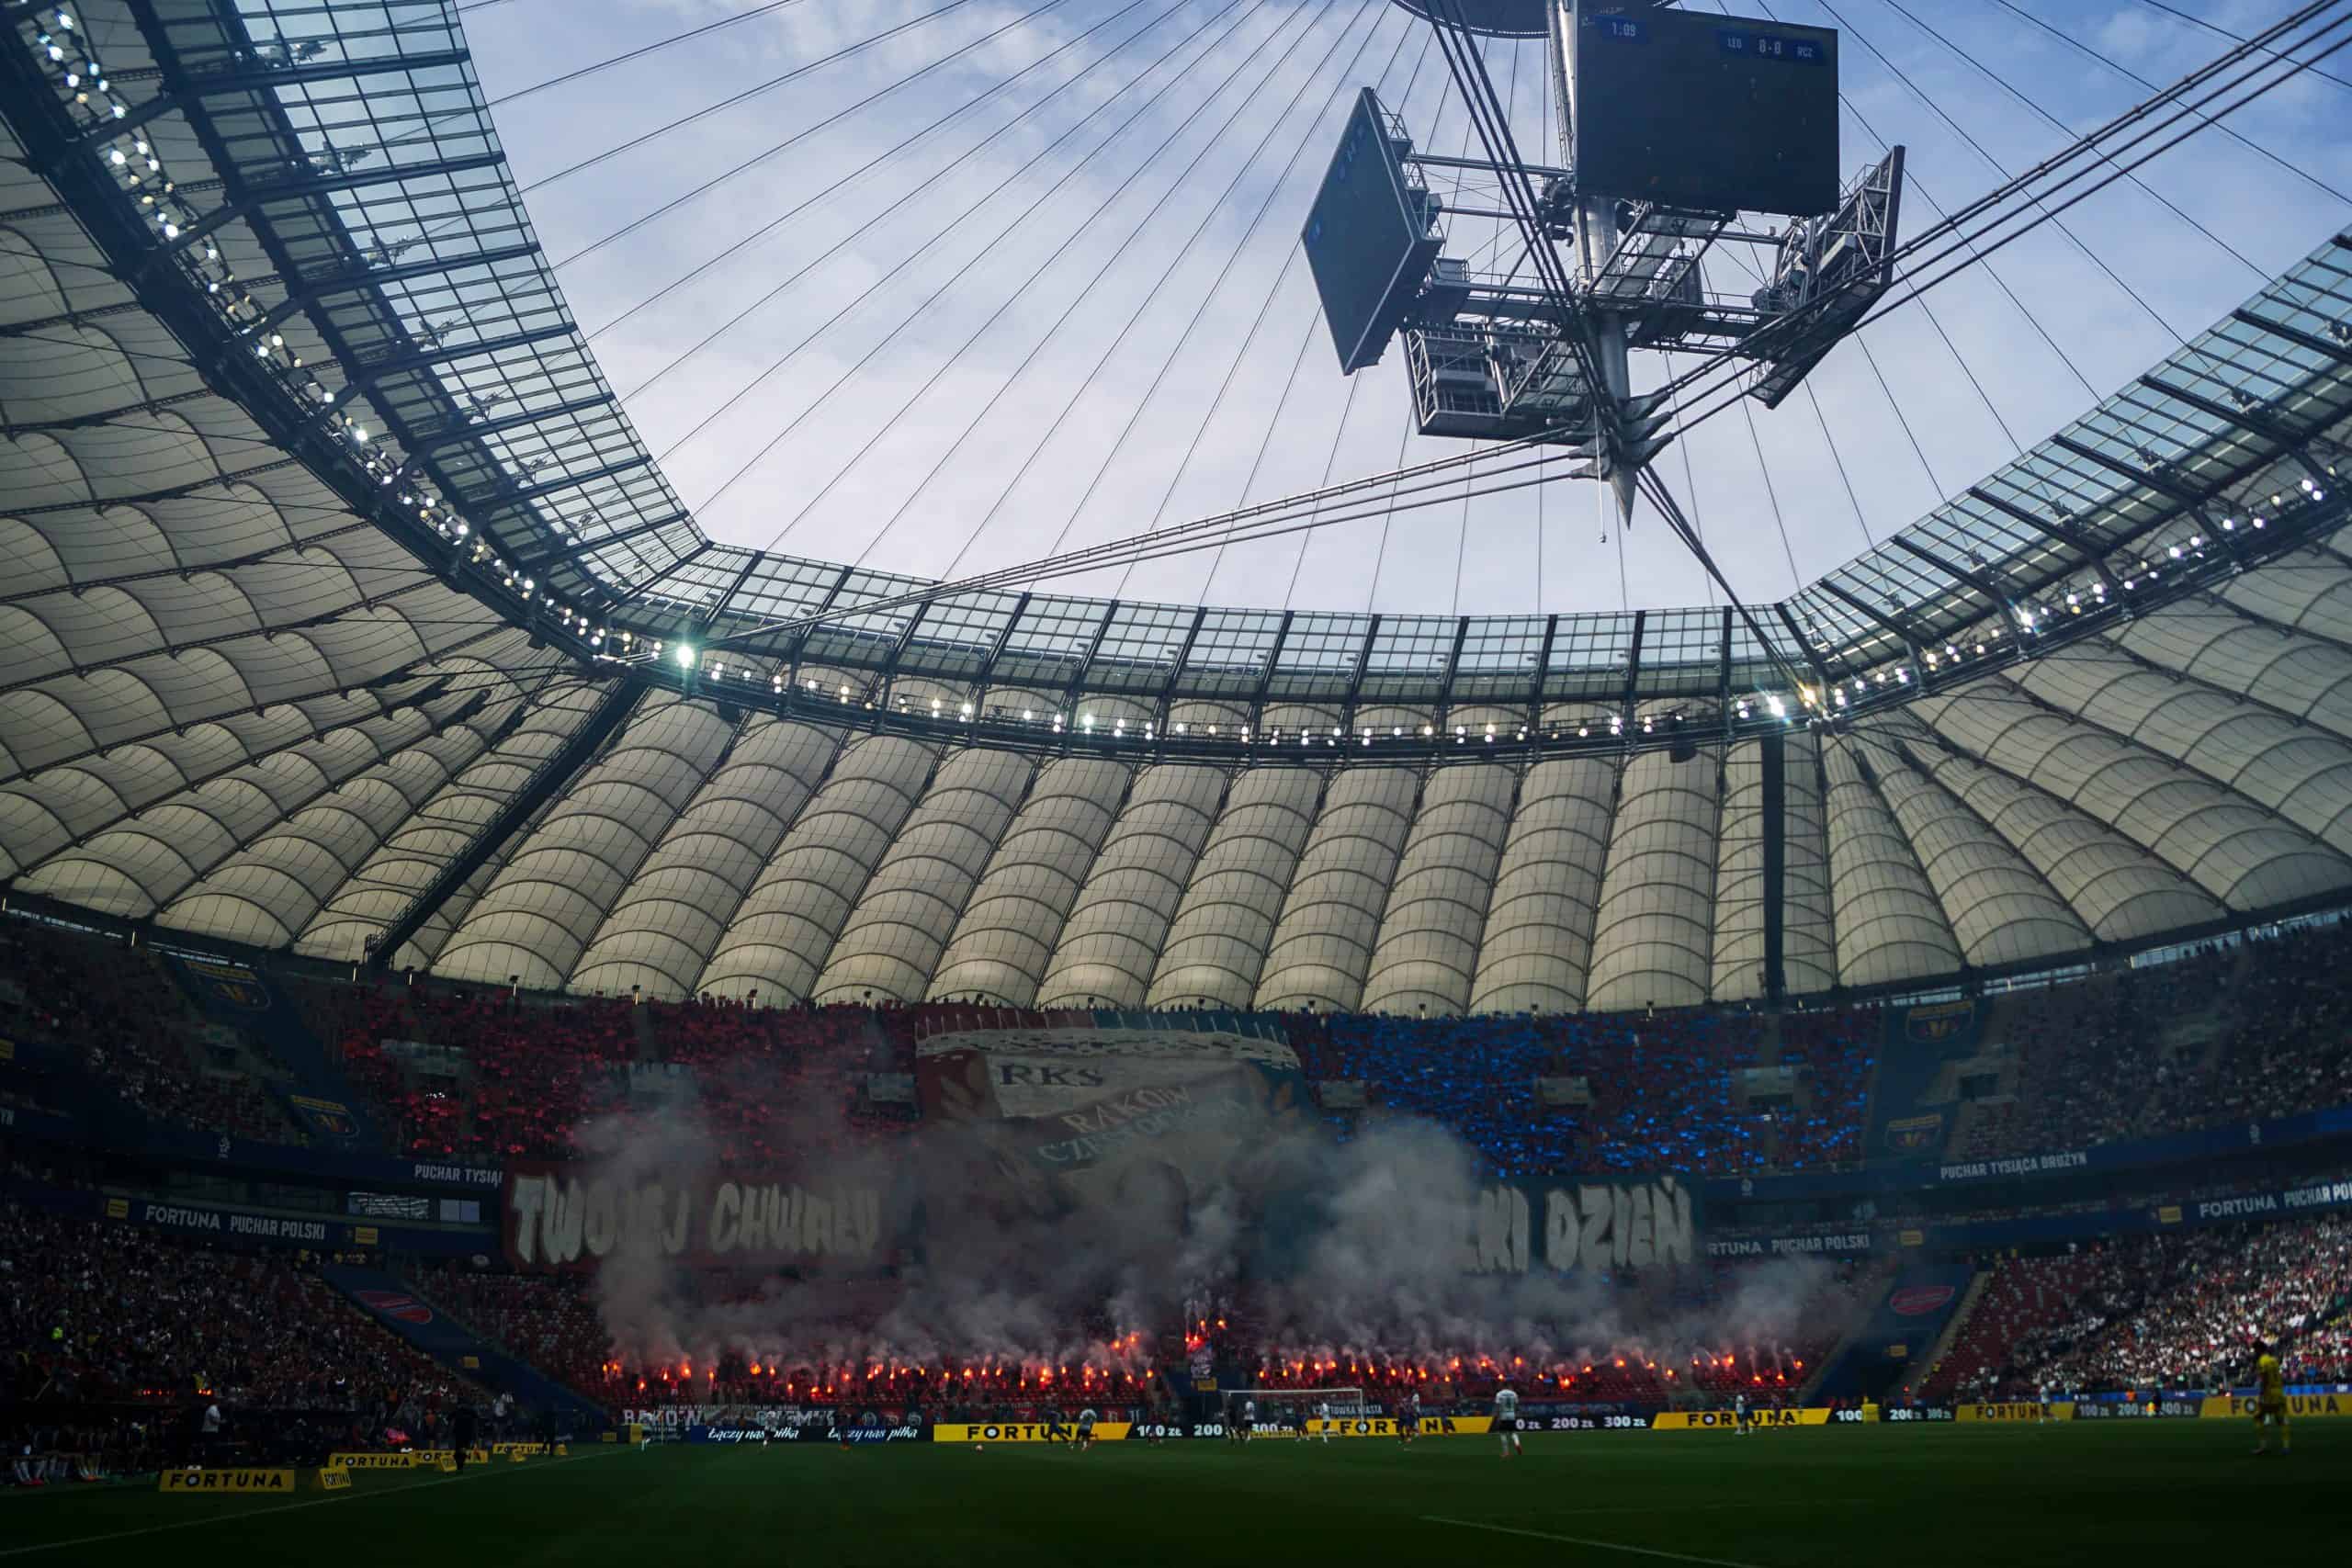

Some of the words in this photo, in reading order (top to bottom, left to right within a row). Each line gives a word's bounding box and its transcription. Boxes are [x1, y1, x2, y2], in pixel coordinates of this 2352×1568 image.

[1001, 1062, 1105, 1088] RKS
[414, 1164, 460, 1181] PUCHAR
[1940, 1163, 1986, 1179] PUCHAR
[1989, 1156, 2039, 1176] TYSIĄCA
[2199, 1194, 2278, 1218] FORTUNA
[2284, 1185, 2331, 1208] PUCHAR
[146, 1204, 221, 1230] FORTUNA
[231, 1214, 277, 1235] PUCHAR
[280, 1220, 326, 1241] POLSKI
[1545, 1176, 1691, 1271] DZIEŃ
[1770, 1237, 1822, 1254] PUCHAR
[1825, 1234, 1871, 1251] POLSKI
[1976, 1404, 2041, 1419] FORTUN
[2231, 1395, 2339, 1414] FOUNA
[1340, 1419, 1455, 1435] FORTNA
[1551, 1417, 1579, 1429] 200
[1602, 1416, 1631, 1428] 300
[1689, 1412, 1796, 1427] FORUNA
[1193, 1424, 1223, 1437] 200
[170, 1472, 285, 1489] FORTUNA
